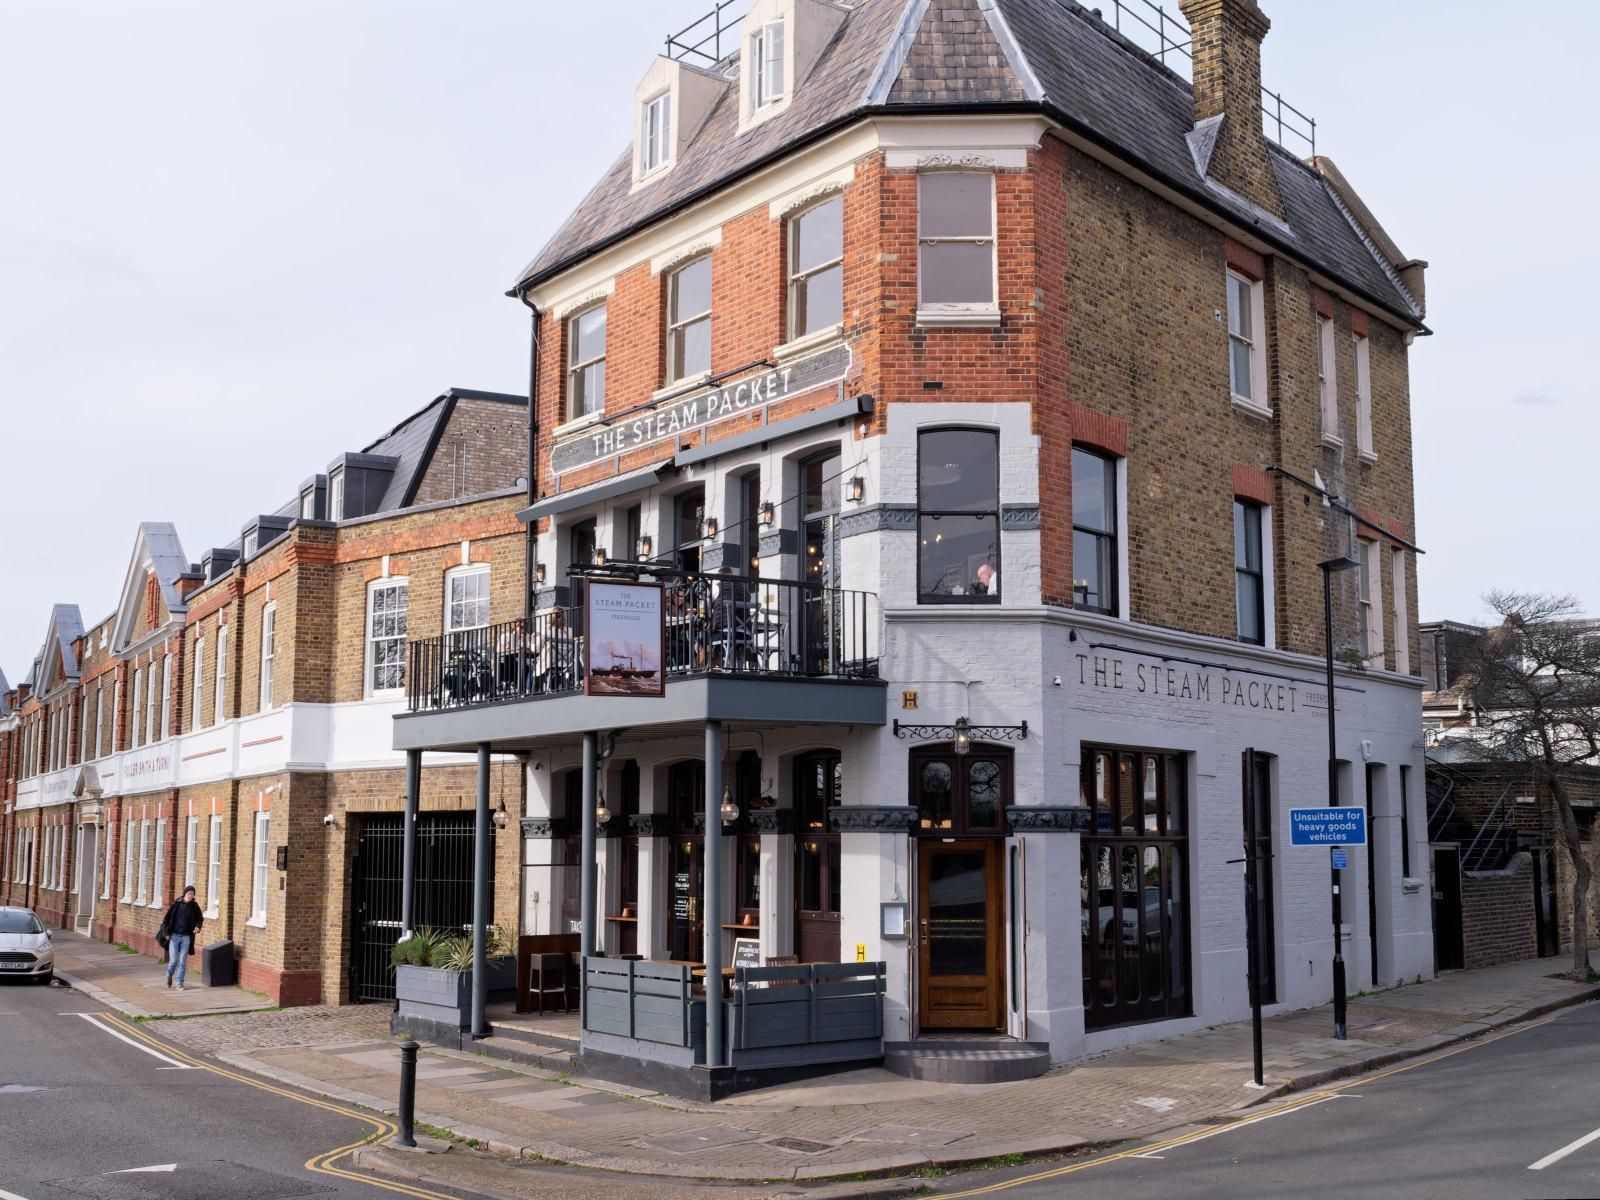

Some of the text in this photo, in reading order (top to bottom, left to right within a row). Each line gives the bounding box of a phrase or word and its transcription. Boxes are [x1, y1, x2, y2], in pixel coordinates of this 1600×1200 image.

[593, 368, 792, 456] THE STEAM PACKET
[625, 601, 656, 609] PACKET
[1076, 654, 1297, 712] THE STEAM PACKET
[1294, 811, 1361, 821] Unsuitable for
[1298, 822, 1357, 832] heavy goods
[1309, 832, 1347, 841] vehicles
